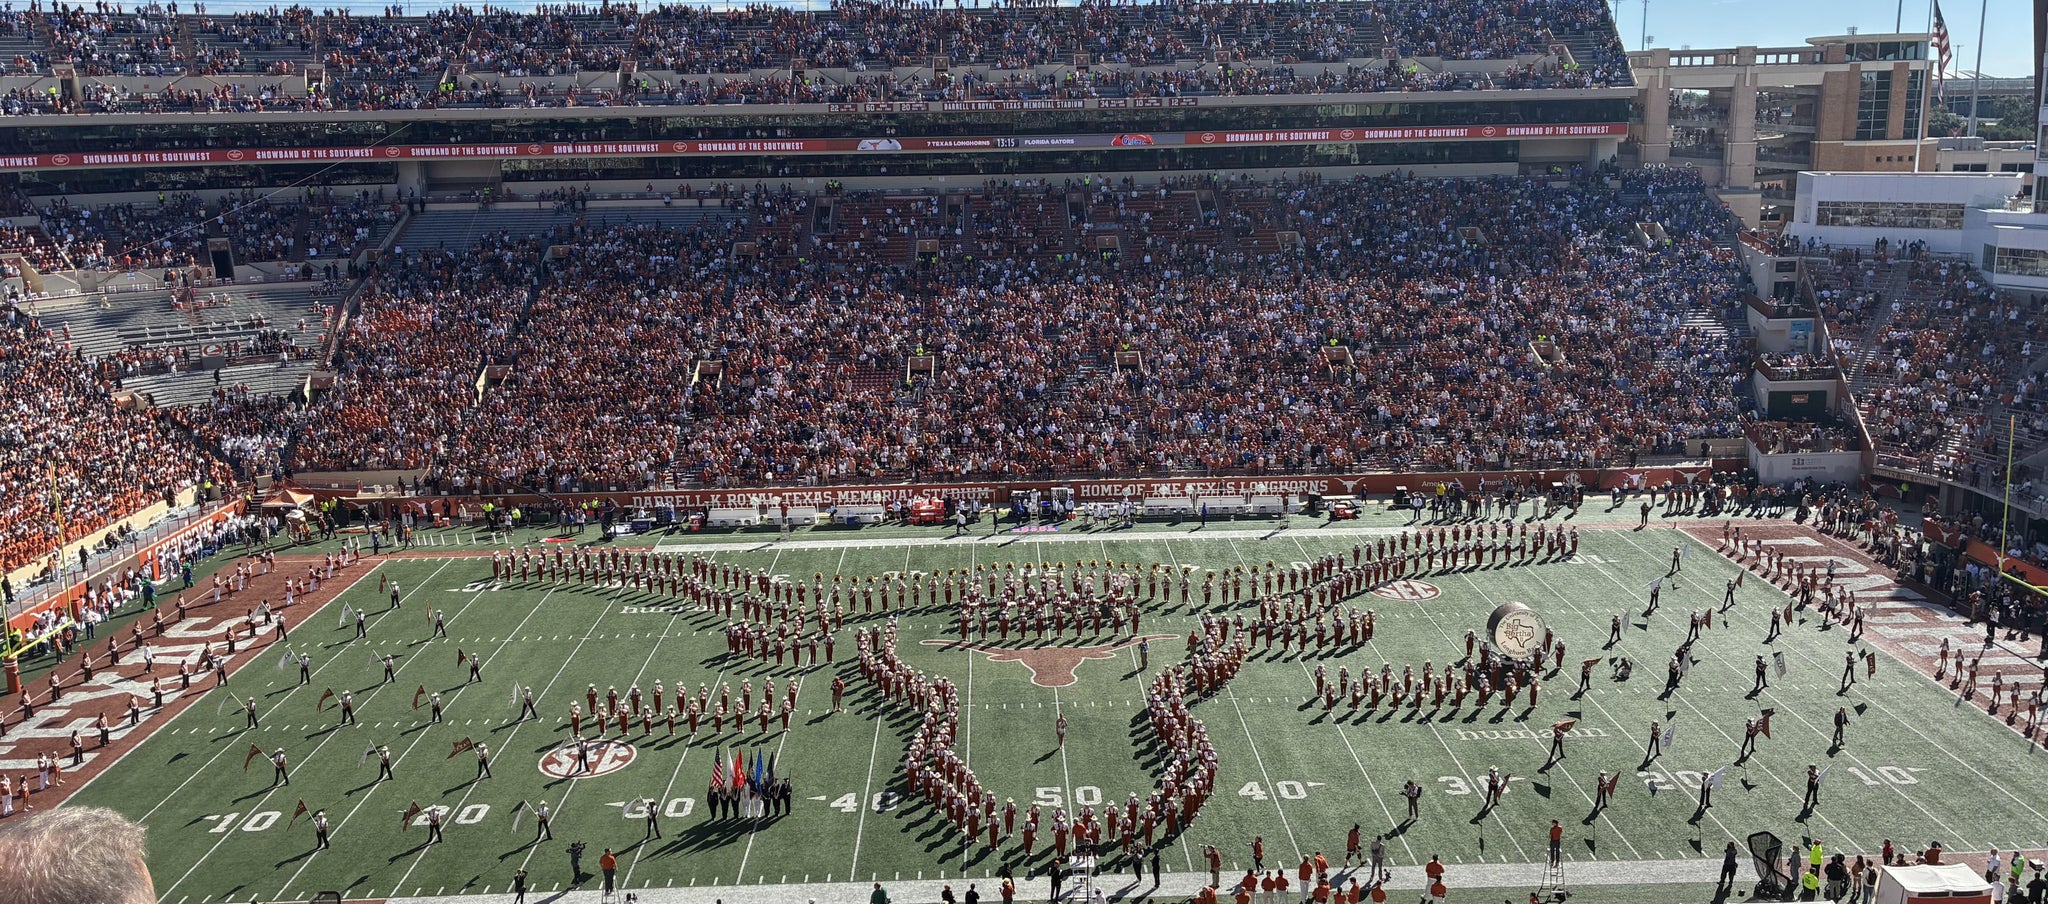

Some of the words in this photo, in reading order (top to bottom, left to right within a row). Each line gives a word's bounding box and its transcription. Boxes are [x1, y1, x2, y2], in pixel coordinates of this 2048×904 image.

[978, 102, 996, 110] ROYAL
[1023, 101, 1054, 109] MEMORIAL
[1365, 130, 1402, 138] SHOWBAND
[1404, 130, 1412, 138] OF
[1414, 129, 1426, 137] THE
[1428, 128, 1468, 137] SOUTHWEST
[1506, 127, 1543, 135] SHOWBAND
[1545, 127, 1553, 135] OF
[1569, 126, 1609, 134] SOUTHWEST
[997, 138, 1015, 147] 13:15
[1226, 134, 1263, 142] SHOWBAND
[1265, 133, 1274, 141] OF
[1276, 133, 1288, 141] THE
[1289, 132, 1330, 140] SOUTHWEST
[411, 148, 450, 156] SHOWBAND
[462, 147, 475, 155] THE
[477, 147, 517, 155] SOUTHWEST
[553, 145, 591, 153] SHOWAND
[594, 145, 602, 153] OF
[618, 144, 659, 152] SOUTHWEST
[698, 143, 736, 151] SHOWBAND
[738, 143, 747, 151] OF
[763, 142, 804, 150] SOUTHWEST
[83, 154, 129, 164] SHOWBAND
[132, 154, 142, 163] OF
[145, 153, 159, 162] THE
[162, 152, 210, 162] SOUTHWEST
[256, 151, 299, 160] SHOWBAND
[302, 150, 311, 158] OF
[313, 150, 327, 158] THE
[329, 149, 373, 158] SOUTHWEST
[1080, 484, 1123, 497] HOME
[1127, 483, 1145, 495] OF
[710, 494, 721, 507] K
[782, 491, 832, 504] TEXAS
[1376, 580, 1438, 599] SEC
[1505, 611, 1529, 620] University
[1506, 623, 1519, 632] Big
[1501, 641, 1527, 656] Longhorn
[1848, 766, 1920, 786] 10
[1238, 780, 1307, 800] 40
[1036, 785, 1103, 807] 50
[830, 792, 899, 813] 40
[411, 804, 491, 826] 20
[211, 811, 282, 833] 10
